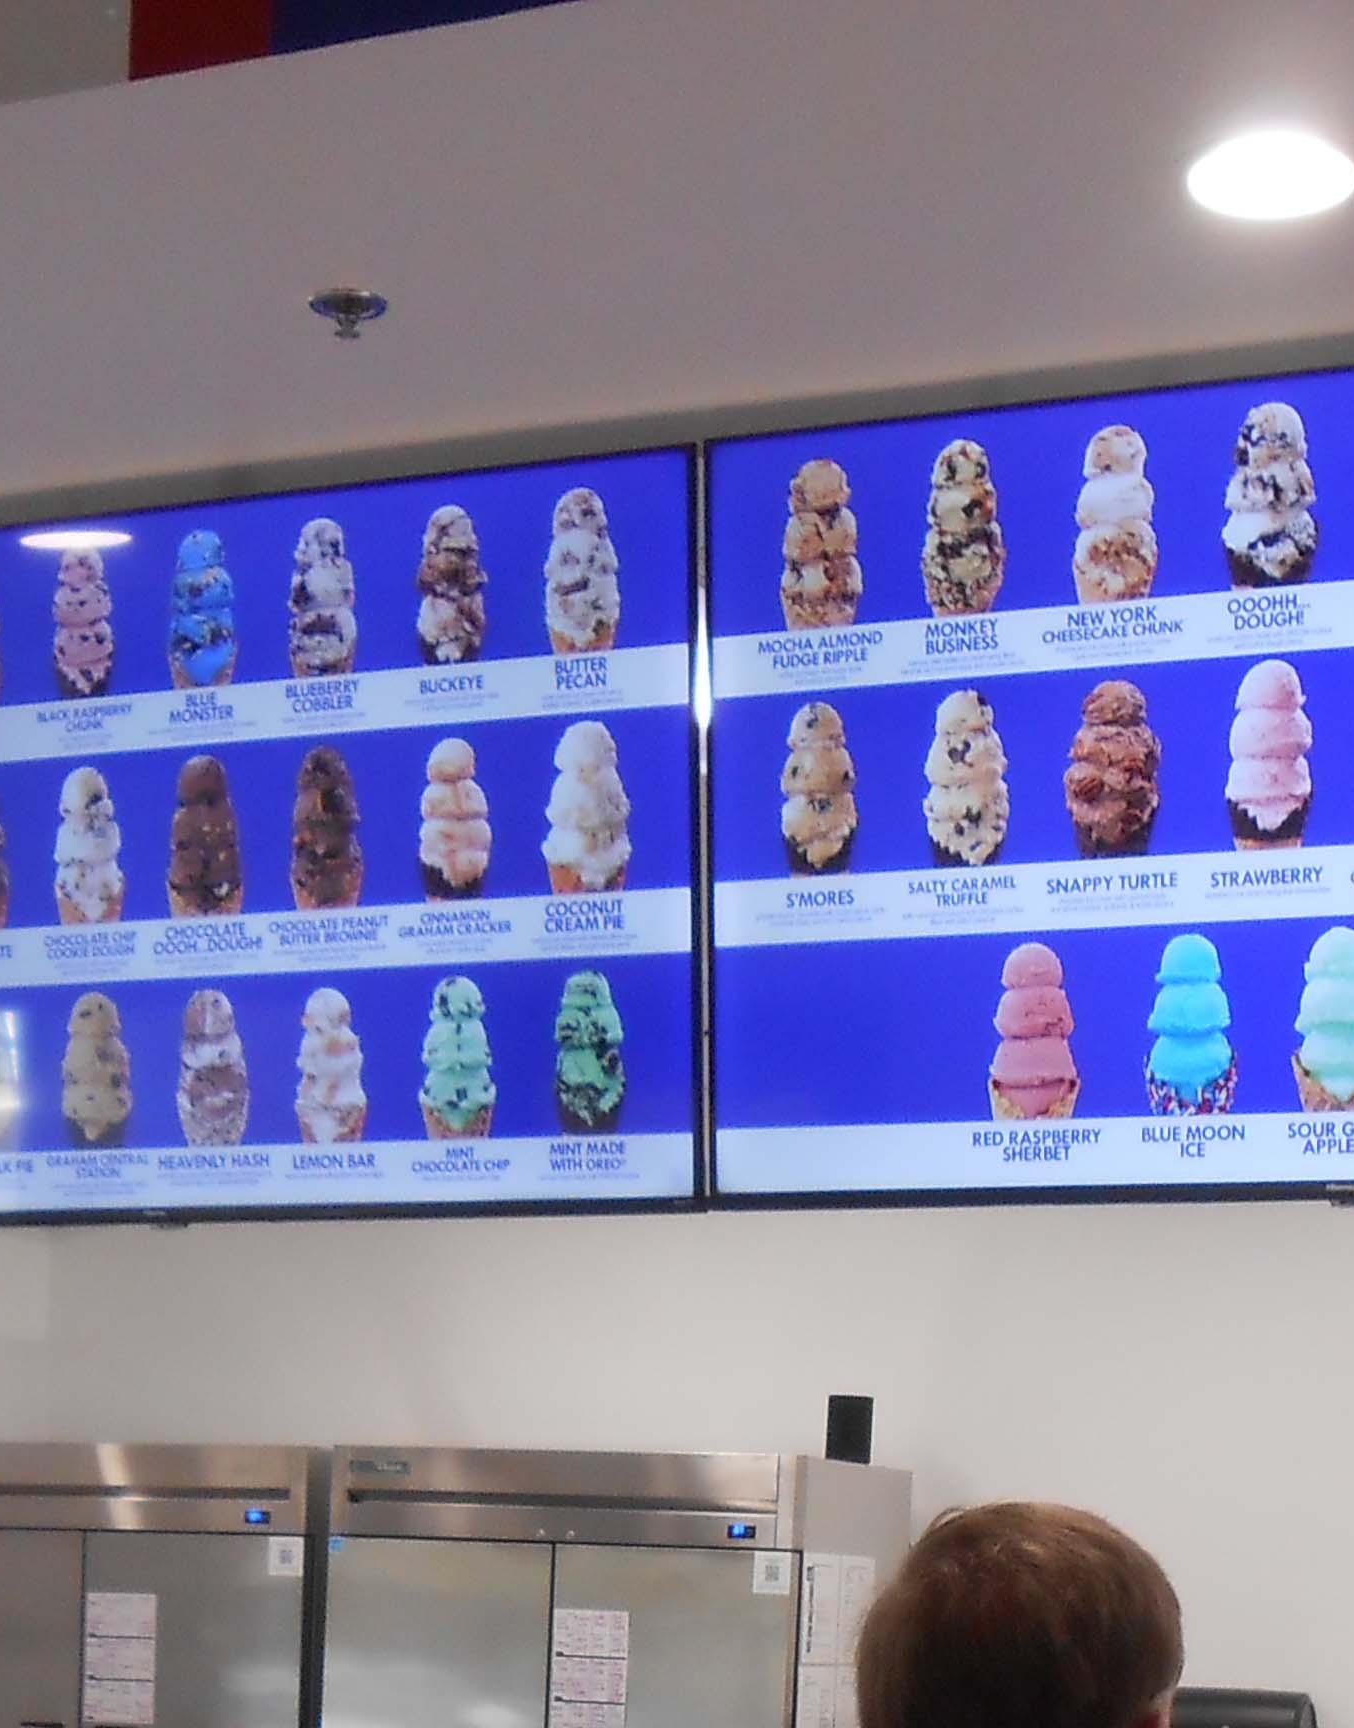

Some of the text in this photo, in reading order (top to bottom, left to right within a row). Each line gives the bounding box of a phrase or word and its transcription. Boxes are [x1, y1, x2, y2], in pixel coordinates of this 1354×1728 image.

[1067, 605, 1157, 627] NEW YORK
[1235, 610, 1304, 630] DOUGH!
[925, 619, 998, 638] MONKEY
[1042, 620, 1183, 644] CHEESECAKE CHUNK
[758, 630, 883, 655] MOCHA ALMOND
[925, 635, 998, 655] BUSINESS
[555, 657, 607, 674] BUTTER
[773, 647, 868, 669] FUDGE RIPPLE
[285, 679, 360, 698] BLUEBERRY
[420, 675, 483, 695] BUCKEYE
[556, 672, 607, 690] PECAN
[185, 692, 218, 706] BLUE
[293, 696, 353, 713] COBBLER
[36, 703, 132, 723] BLACK RASPBERRY
[169, 705, 233, 723] MONSTER
[908, 875, 1017, 896] SALTY CARAMEL
[1047, 872, 1178, 894] SNAPPY TURTLE
[1210, 866, 1323, 888] STRAWBERRY
[545, 899, 622, 916] COCONUT
[786, 889, 855, 909] S'MORES
[935, 892, 988, 907] TRUFFLE
[269, 915, 389, 934] CHOCOLATE PEANUT
[420, 910, 490, 925] CINNAMON
[545, 914, 625, 933] CREAM PIE
[165, 922, 245, 940] CHOCOLATE
[280, 928, 378, 946] BUTTER BROWNIE
[399, 921, 511, 938] GRAHAM CRACKER
[44, 930, 137, 948] CHOCOLATE CHIP
[47, 944, 135, 960] COOKIE DOUGH
[972, 1128, 1101, 1147] RED RASPBERRY
[1141, 1125, 1245, 1142] BLUE MOON
[1288, 1122, 1335, 1138] SOUR
[446, 1147, 474, 1159] MINT
[549, 1140, 626, 1157] MINT MADE
[1003, 1145, 1071, 1162] SHERBET
[1180, 1142, 1206, 1158] ICE
[1303, 1138, 1354, 1154] APPLE
[158, 1153, 270, 1170] HEAVENLY HASH
[293, 1153, 375, 1170] LEMON BAR
[412, 1159, 510, 1173] CHOCOLATE CHIP
[550, 1157, 582, 1172] WITH
